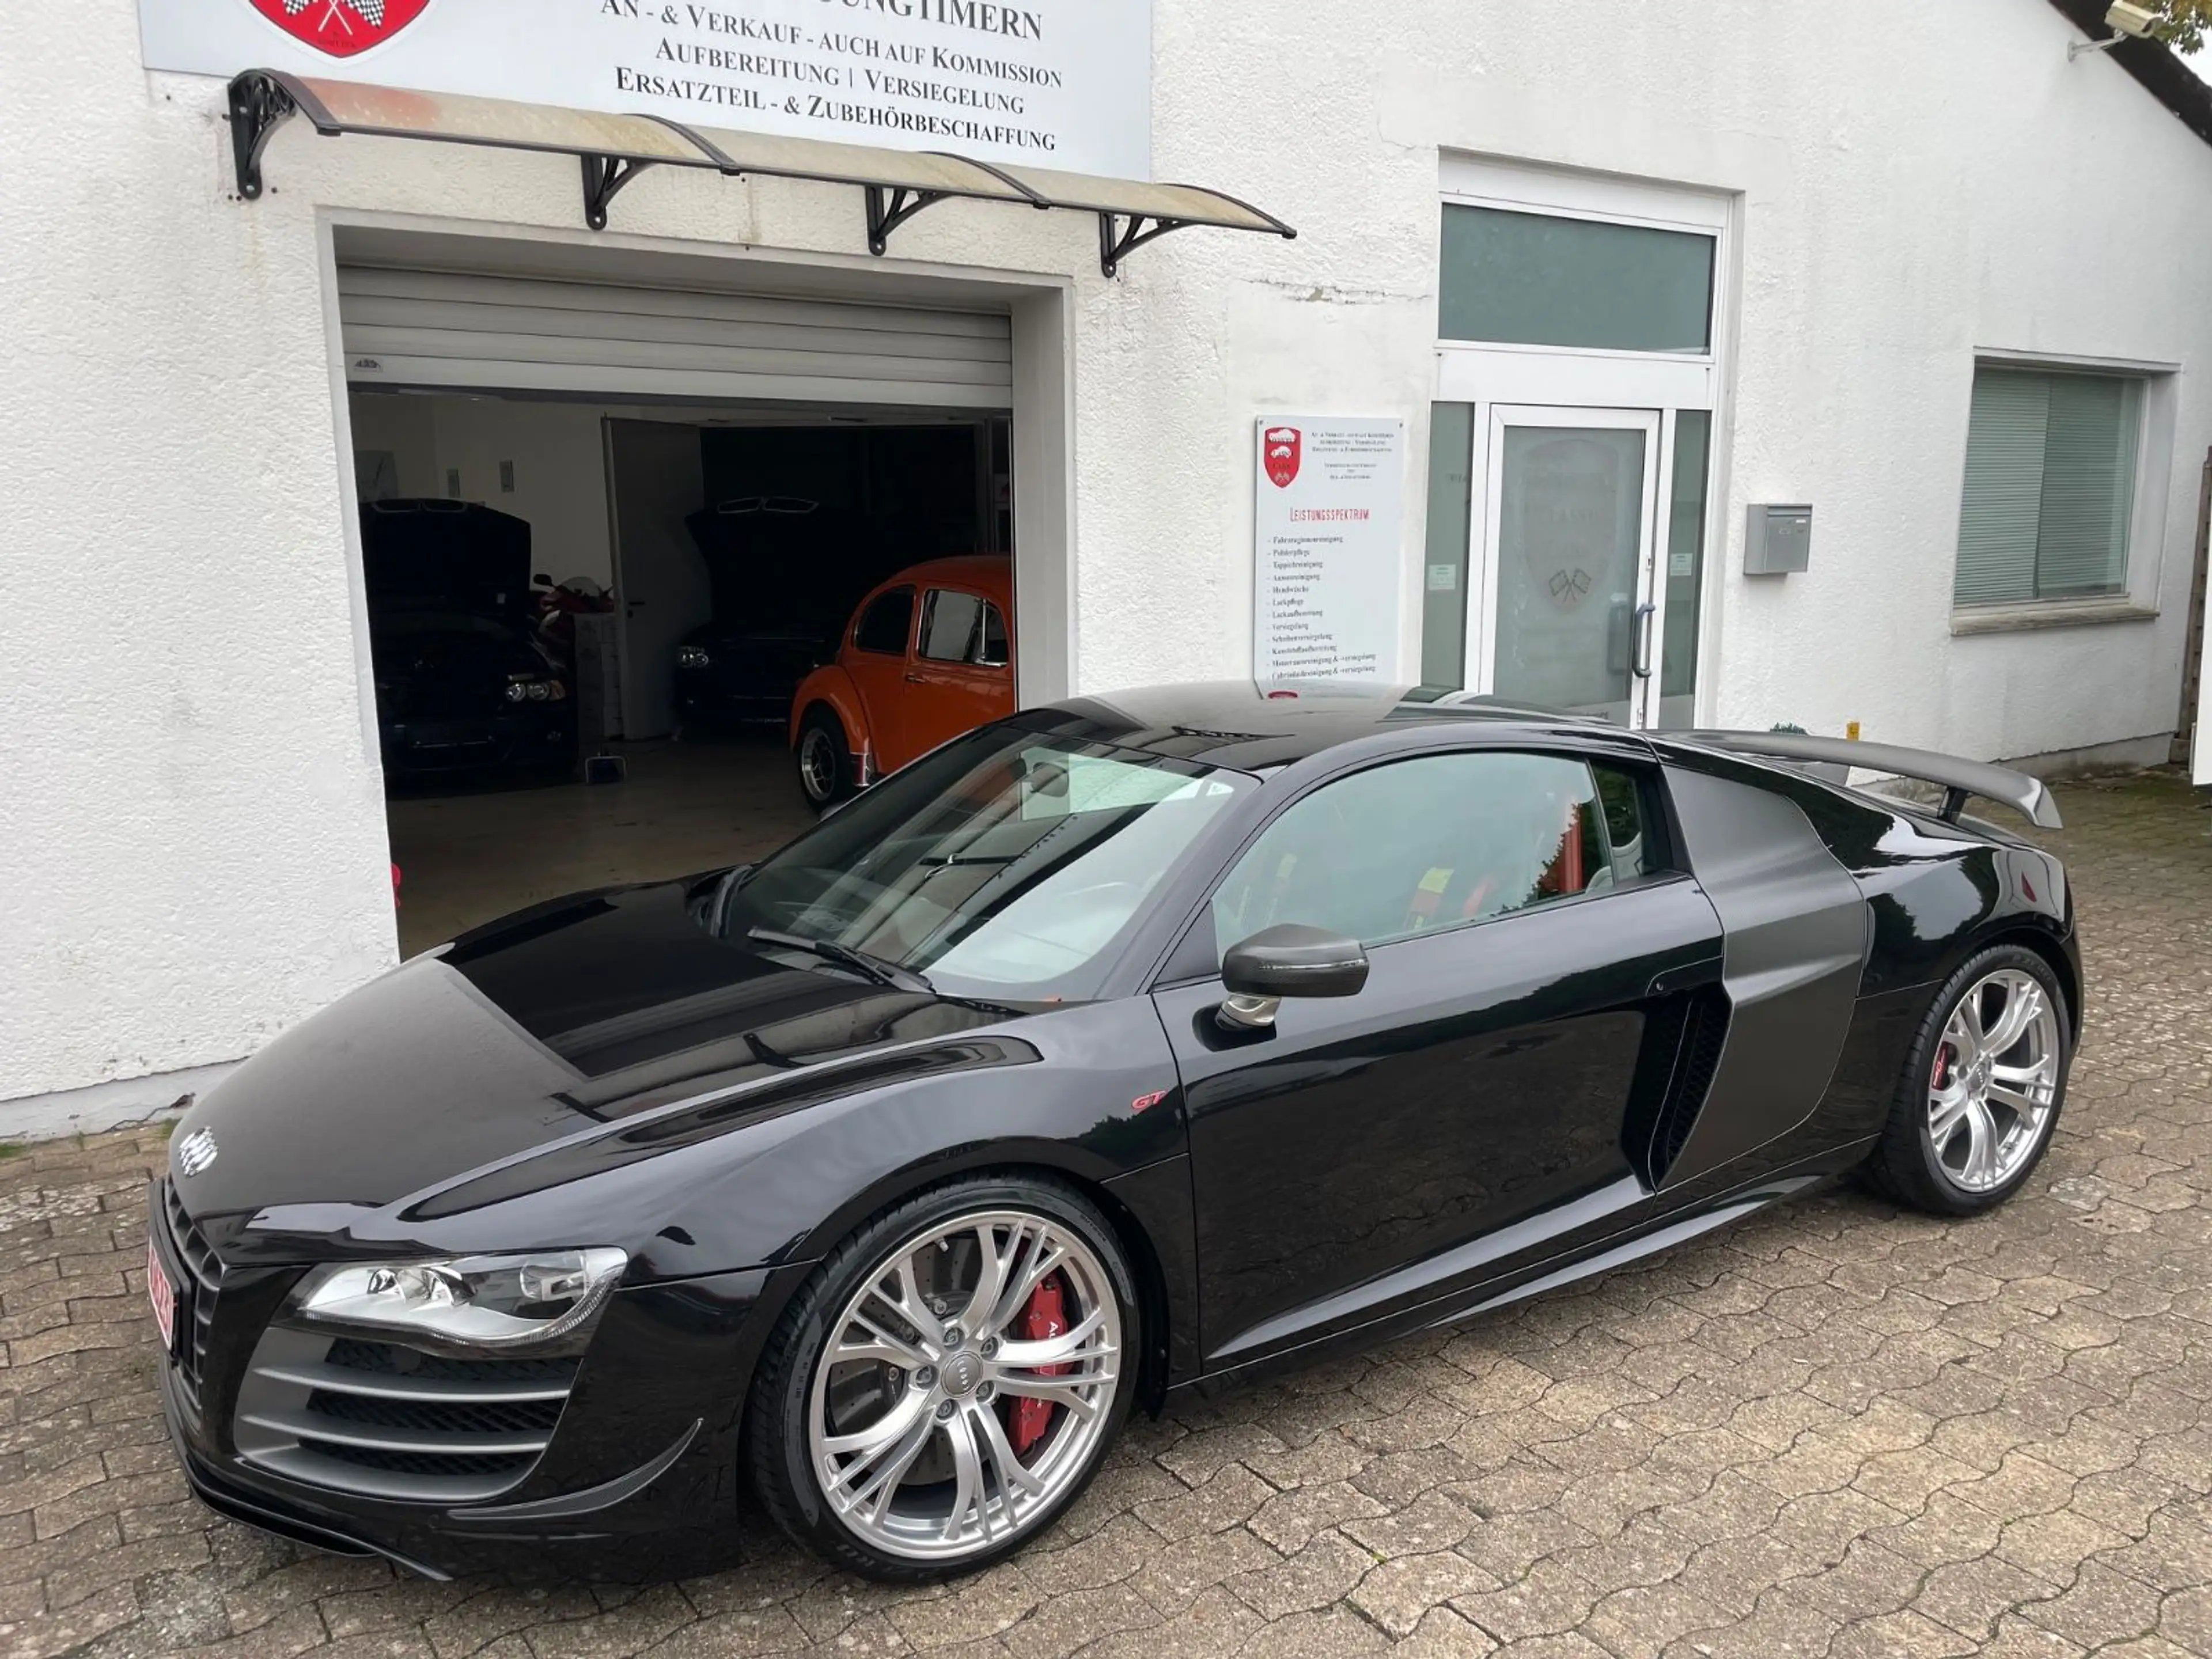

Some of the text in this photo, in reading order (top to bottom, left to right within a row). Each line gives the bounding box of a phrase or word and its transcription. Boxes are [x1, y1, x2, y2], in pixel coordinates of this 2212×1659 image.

[656, 37, 839, 86] AUFBEREITUNG
[865, 69, 1024, 115] VERSIEGELUNG
[661, 5, 679, 24] &
[687, 4, 802, 44] VERKAUF
[819, 33, 880, 58] AUCH
[885, 44, 926, 64] AUF
[931, 46, 1062, 88] KOMMISSION
[615, 66, 766, 110] ERSATZTEIL
[784, 96, 800, 115] &
[807, 94, 1055, 151] ZUBEHÖRBESCHAFFUNG
